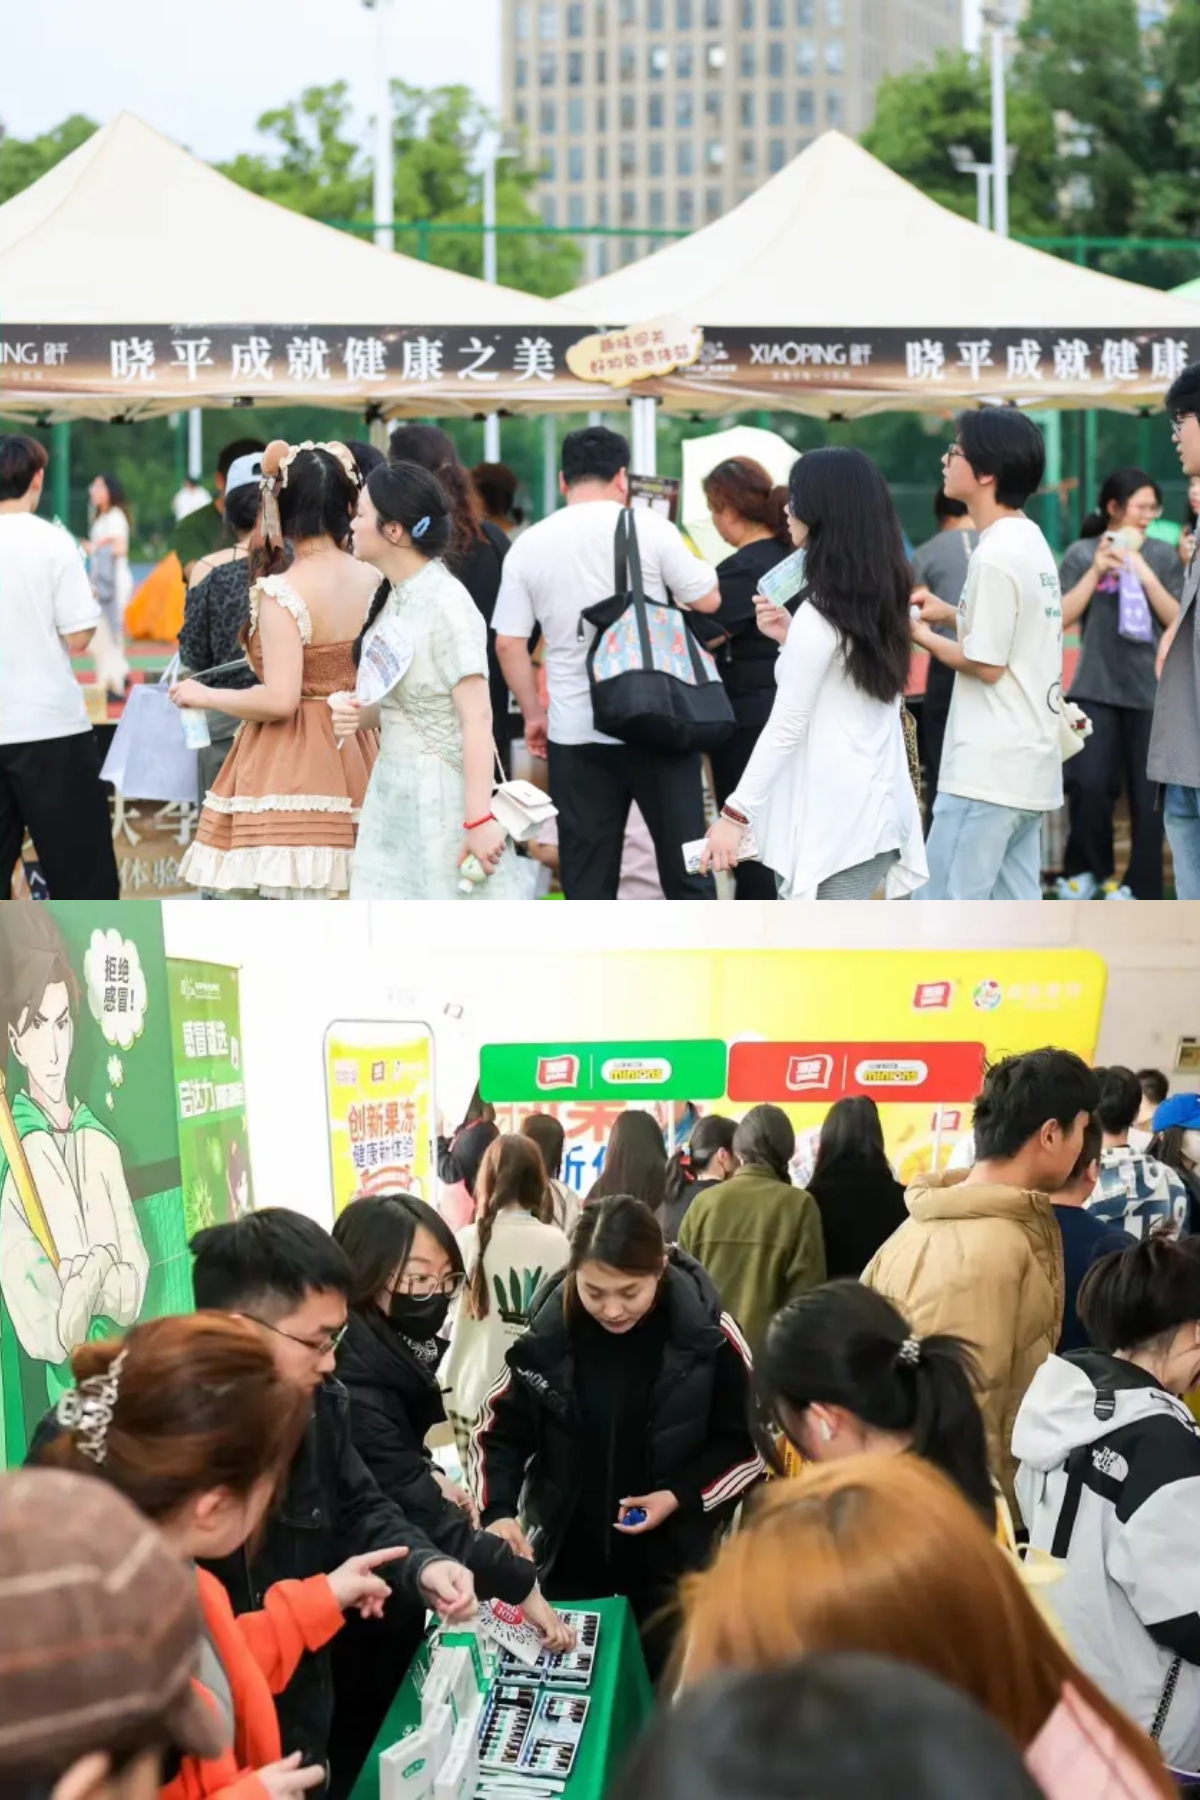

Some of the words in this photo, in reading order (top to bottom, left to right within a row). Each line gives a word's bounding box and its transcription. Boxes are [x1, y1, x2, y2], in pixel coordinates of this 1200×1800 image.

[109, 336, 557, 382] 晓平成就健康之美
[749, 341, 846, 365] XIAOPING
[904, 339, 1189, 384] 晓平成就健康
[103, 955, 131, 983] 拒绝
[348, 1098, 416, 1143] 创新果冻
